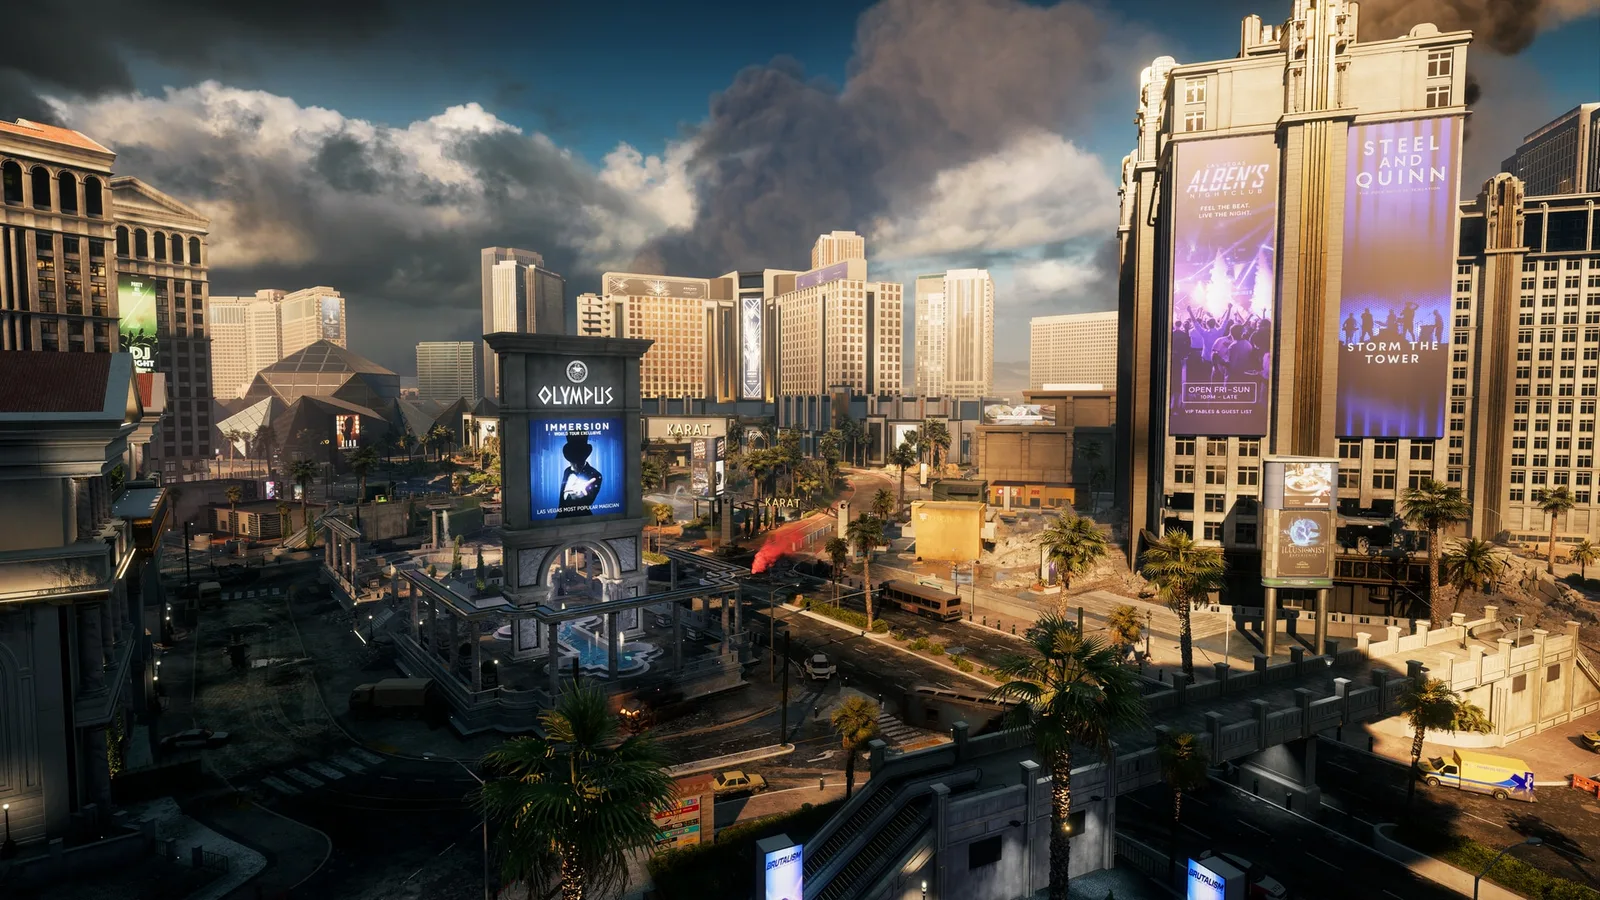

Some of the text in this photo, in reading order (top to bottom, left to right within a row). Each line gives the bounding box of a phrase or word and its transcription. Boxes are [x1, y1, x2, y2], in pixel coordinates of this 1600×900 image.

[1364, 135, 1439, 156] STEEL
[1379, 154, 1422, 169] AND
[1186, 164, 1270, 193] ALBEN'S
[1355, 166, 1446, 189] QUINN
[1189, 189, 1263, 199] NIGHTCLUB
[129, 346, 151, 360] DJ
[1347, 341, 1439, 352] STORM THE
[1365, 354, 1419, 364] TOWER
[537, 385, 614, 405] OLYMPUS
[1188, 386, 1212, 394] OPEN
[545, 422, 609, 432] IMMERSION
[667, 423, 711, 436] KARAT
[598, 502, 620, 510] MAGICIAN
[765, 497, 800, 508] KARAT
[1281, 546, 1325, 554] ILLUSIONIST
[766, 850, 802, 871] BRUTALISM
[1188, 868, 1225, 892] BRUTALISM
